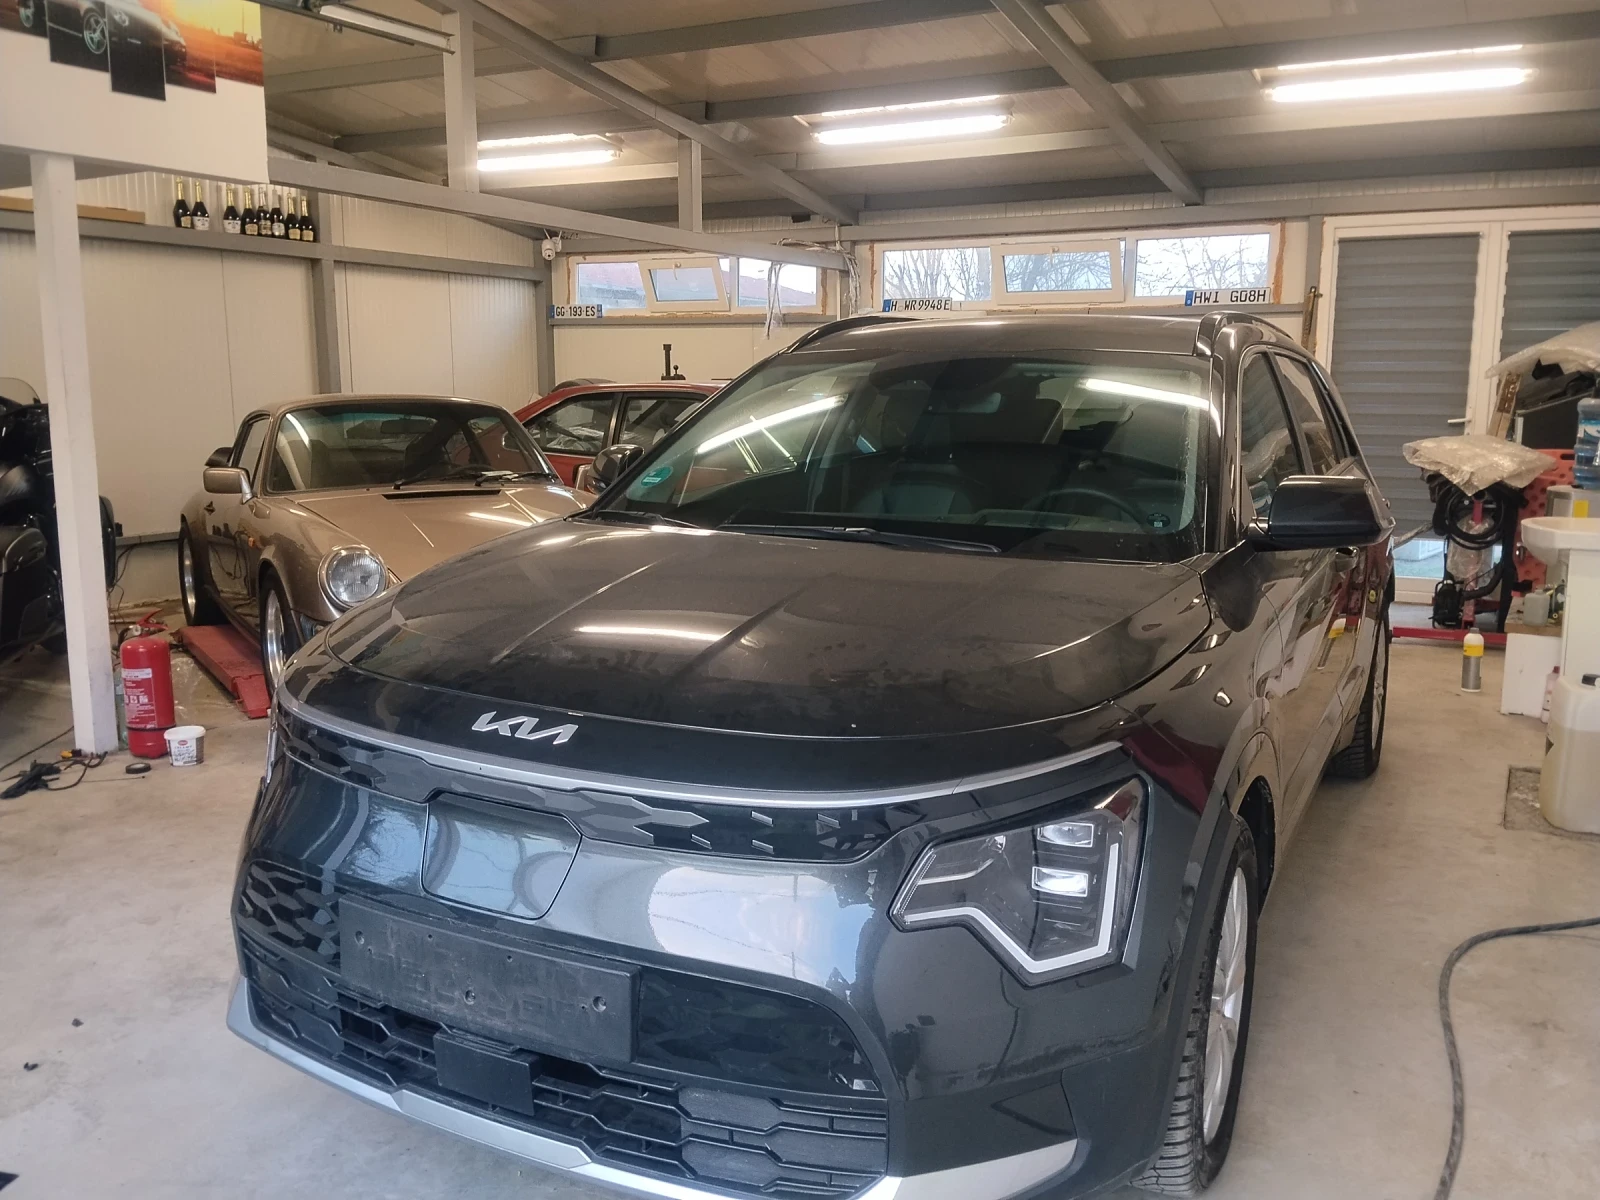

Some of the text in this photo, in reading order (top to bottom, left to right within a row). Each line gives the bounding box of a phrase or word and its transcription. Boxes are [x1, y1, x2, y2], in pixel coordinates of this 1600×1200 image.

[1193, 291, 1220, 304] HWI
[890, 300, 898, 312] H
[471, 711, 579, 745] KIA
